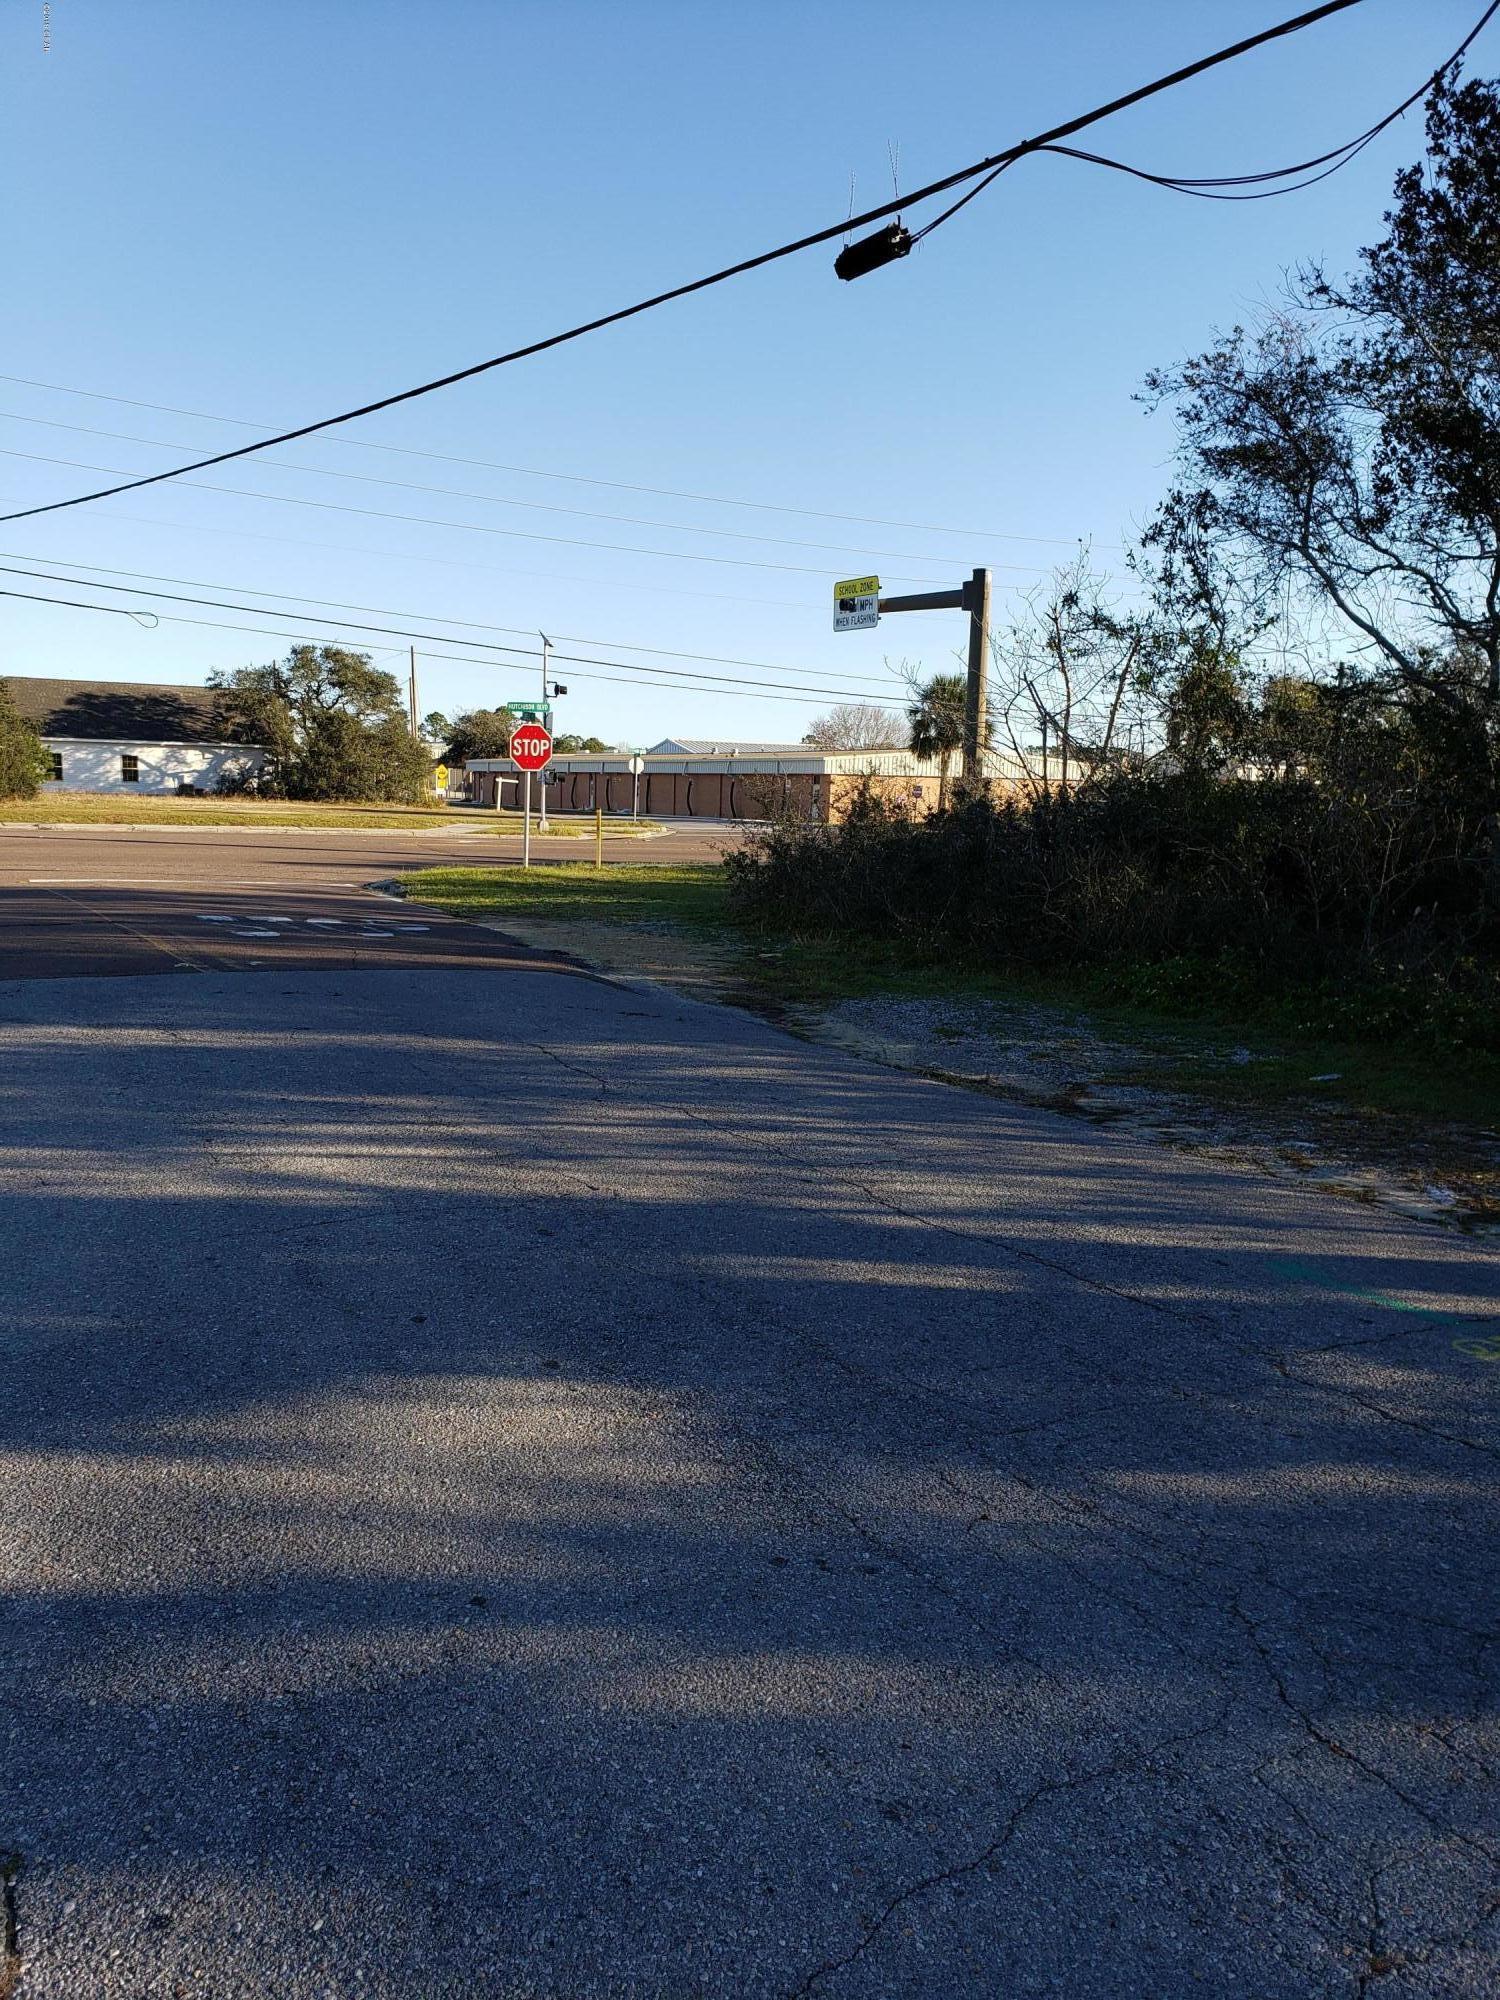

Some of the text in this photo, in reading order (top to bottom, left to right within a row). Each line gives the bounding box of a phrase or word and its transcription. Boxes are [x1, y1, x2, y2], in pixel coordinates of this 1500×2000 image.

[839, 581, 874, 596] SCHOOL ZONE
[851, 613, 876, 625] FLASHING
[513, 738, 550, 757] STOP
